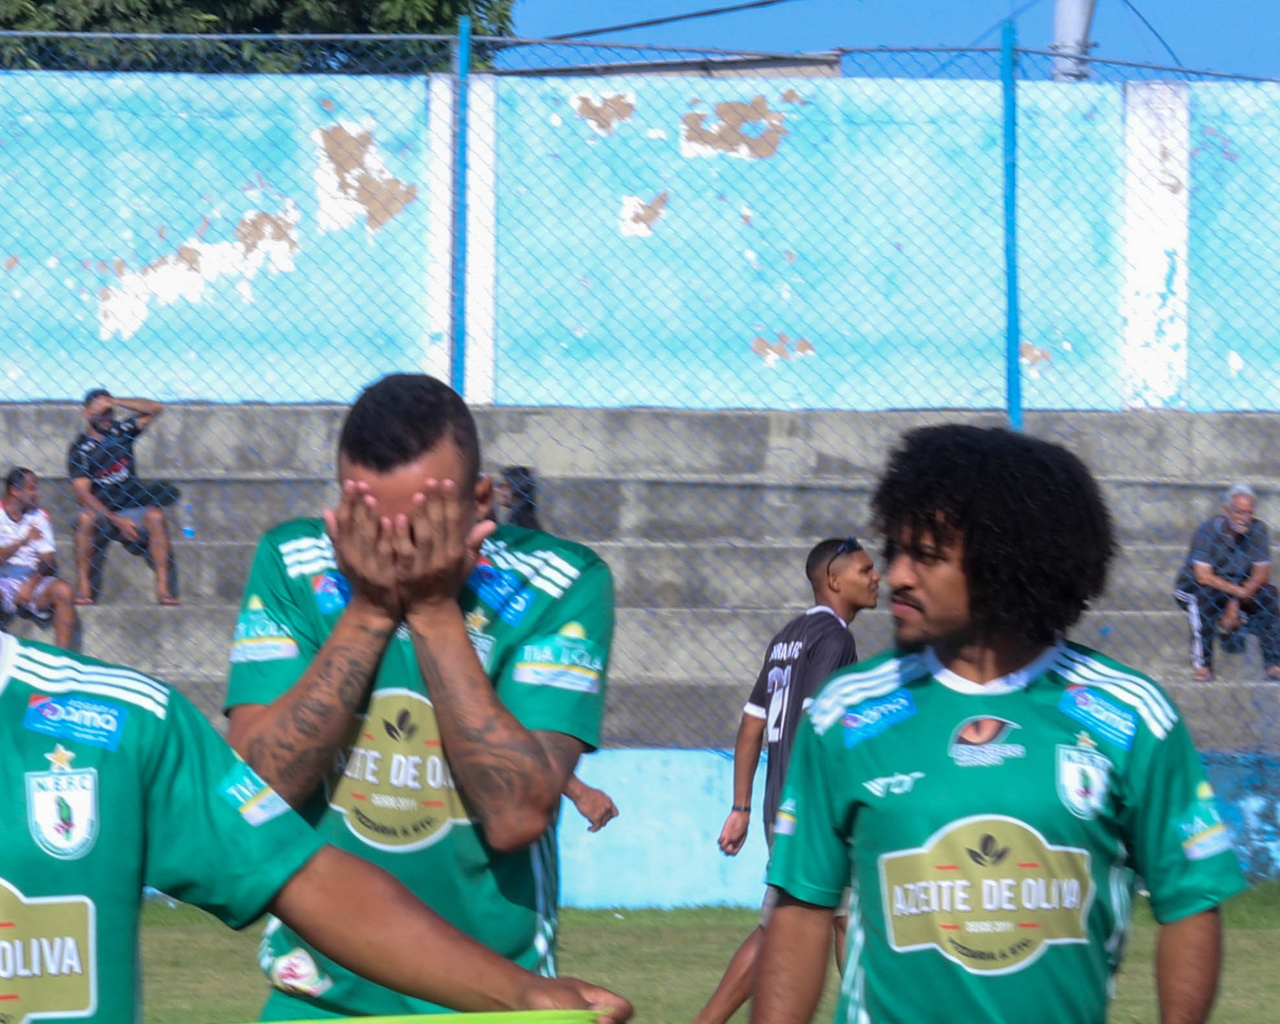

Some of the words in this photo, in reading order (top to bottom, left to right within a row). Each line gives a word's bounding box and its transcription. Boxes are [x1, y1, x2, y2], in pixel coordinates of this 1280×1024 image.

[389, 753, 423, 789] DE
[893, 880, 973, 916] AZEITE
[982, 878, 1018, 911] DE
